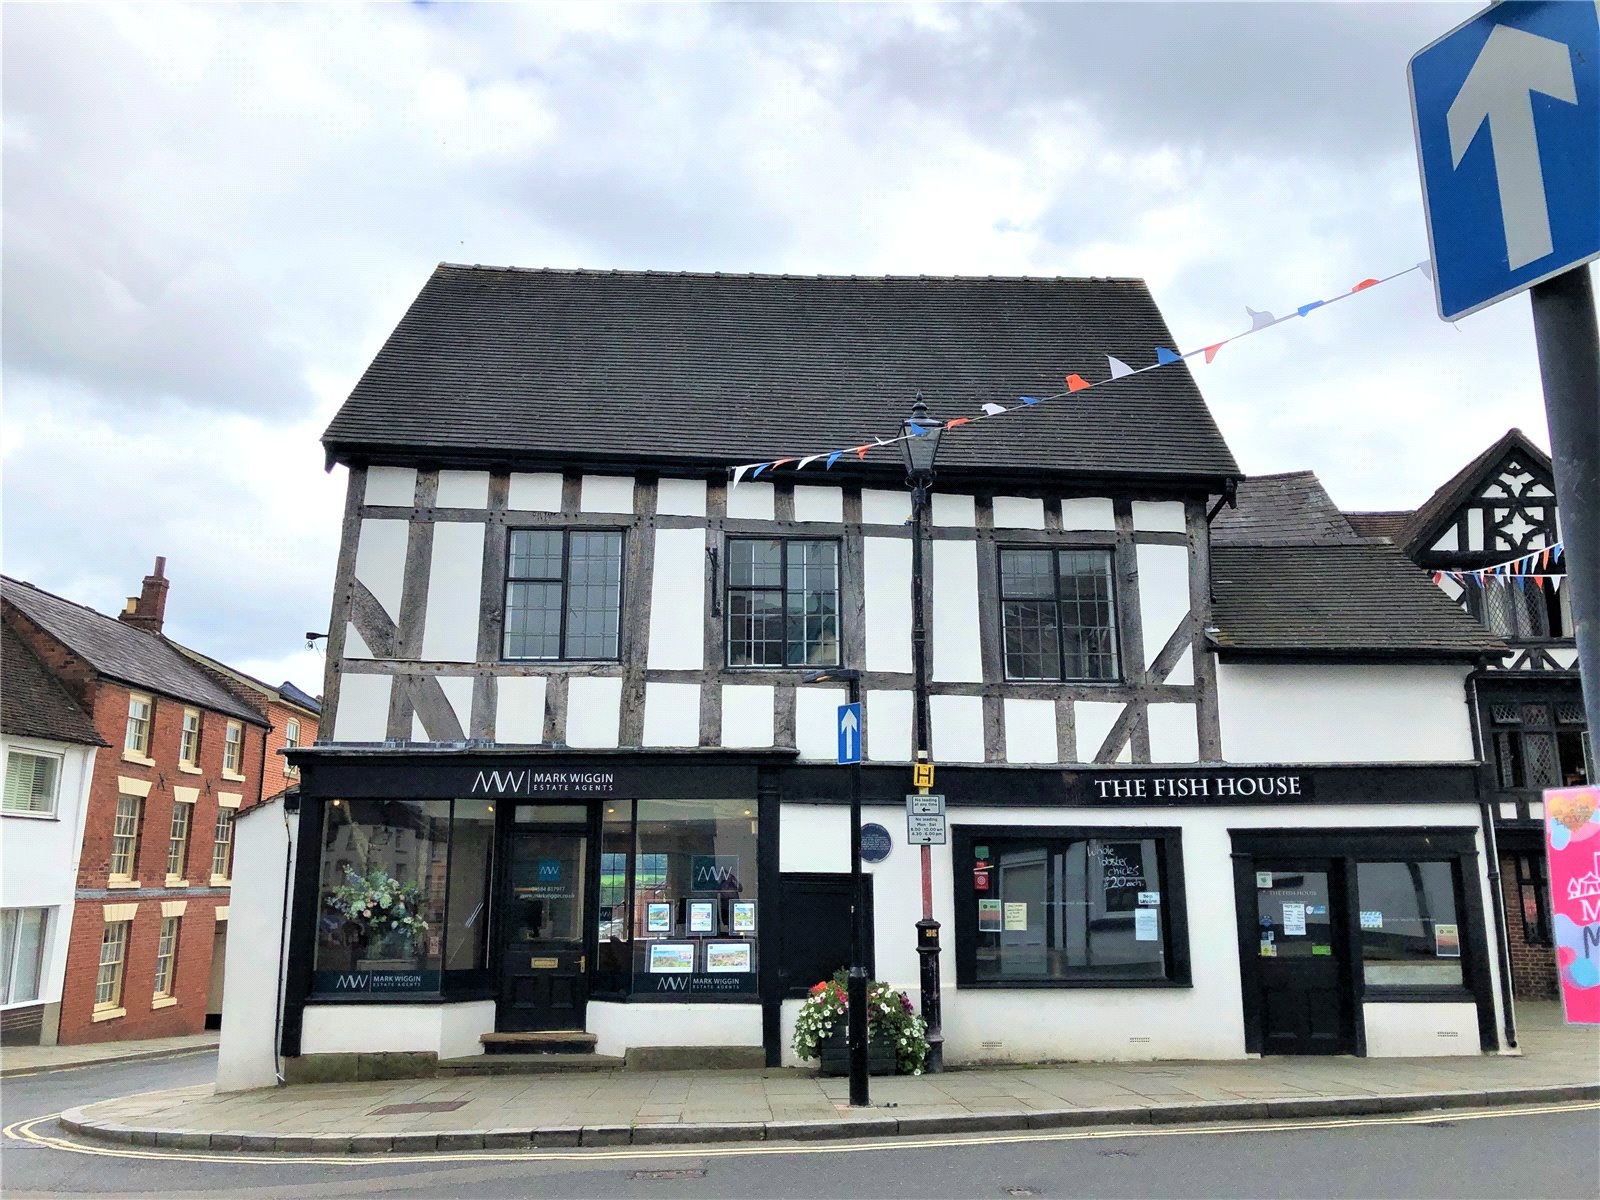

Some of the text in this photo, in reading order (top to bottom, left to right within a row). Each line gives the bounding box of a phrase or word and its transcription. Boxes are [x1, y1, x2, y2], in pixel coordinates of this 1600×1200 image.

[534, 773, 614, 783] MARK WIGGIN
[917, 766, 931, 784] H
[1095, 776, 1302, 798] THE FISH HOUSE
[1087, 845, 1114, 857] Whole
